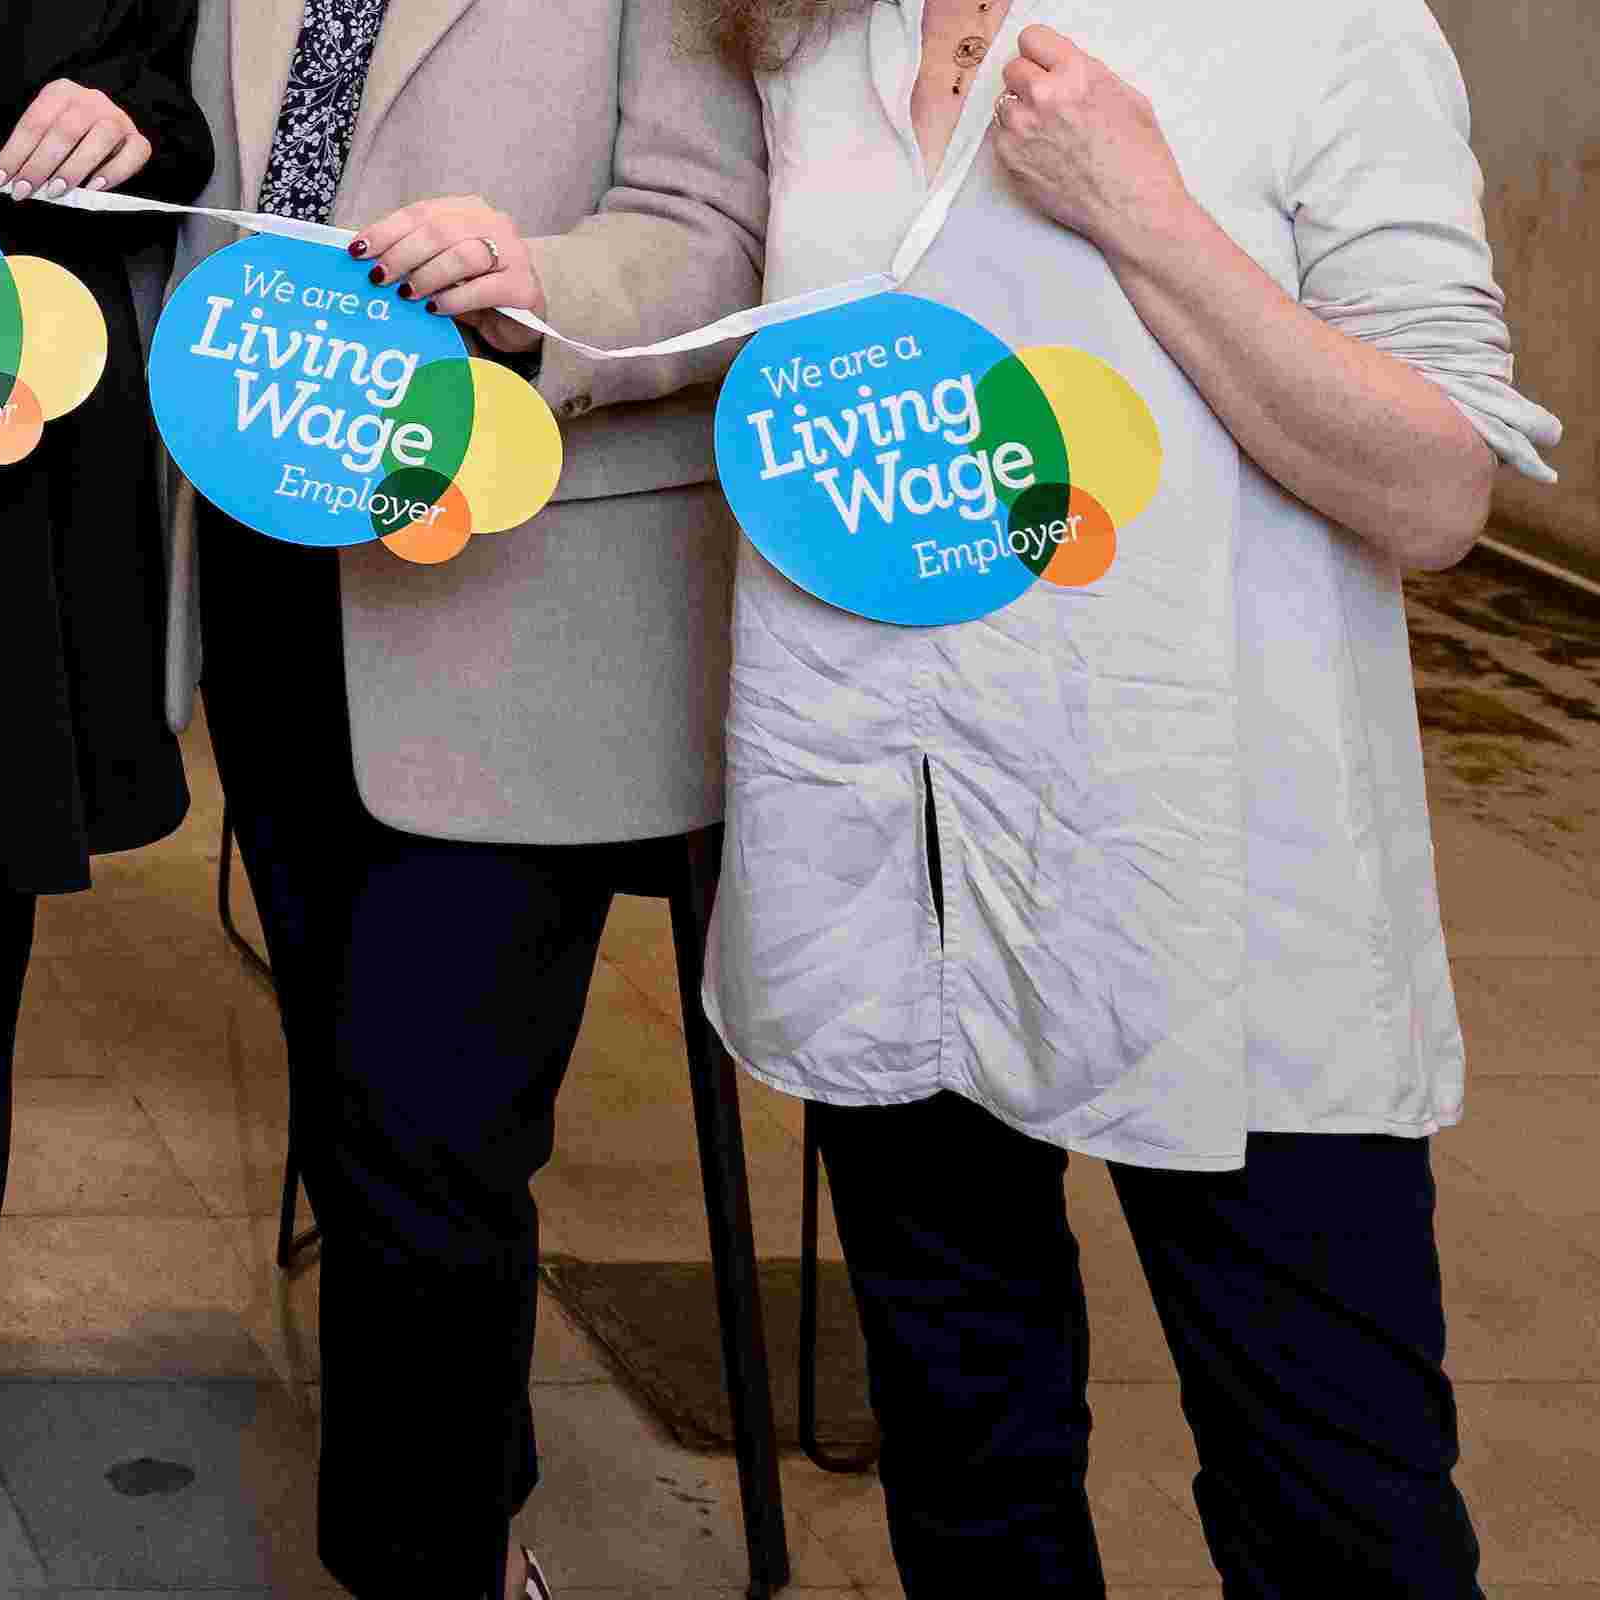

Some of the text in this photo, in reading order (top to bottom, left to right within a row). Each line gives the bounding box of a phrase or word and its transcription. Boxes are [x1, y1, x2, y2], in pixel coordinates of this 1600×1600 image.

[241, 264, 391, 321] We are a
[189, 296, 419, 408] Living
[760, 334, 922, 401] We are a
[232, 368, 433, 474] Wage
[747, 372, 981, 481] Living
[274, 463, 447, 527] Employer
[814, 439, 1036, 535] Wage
[912, 513, 1083, 579] Employer
